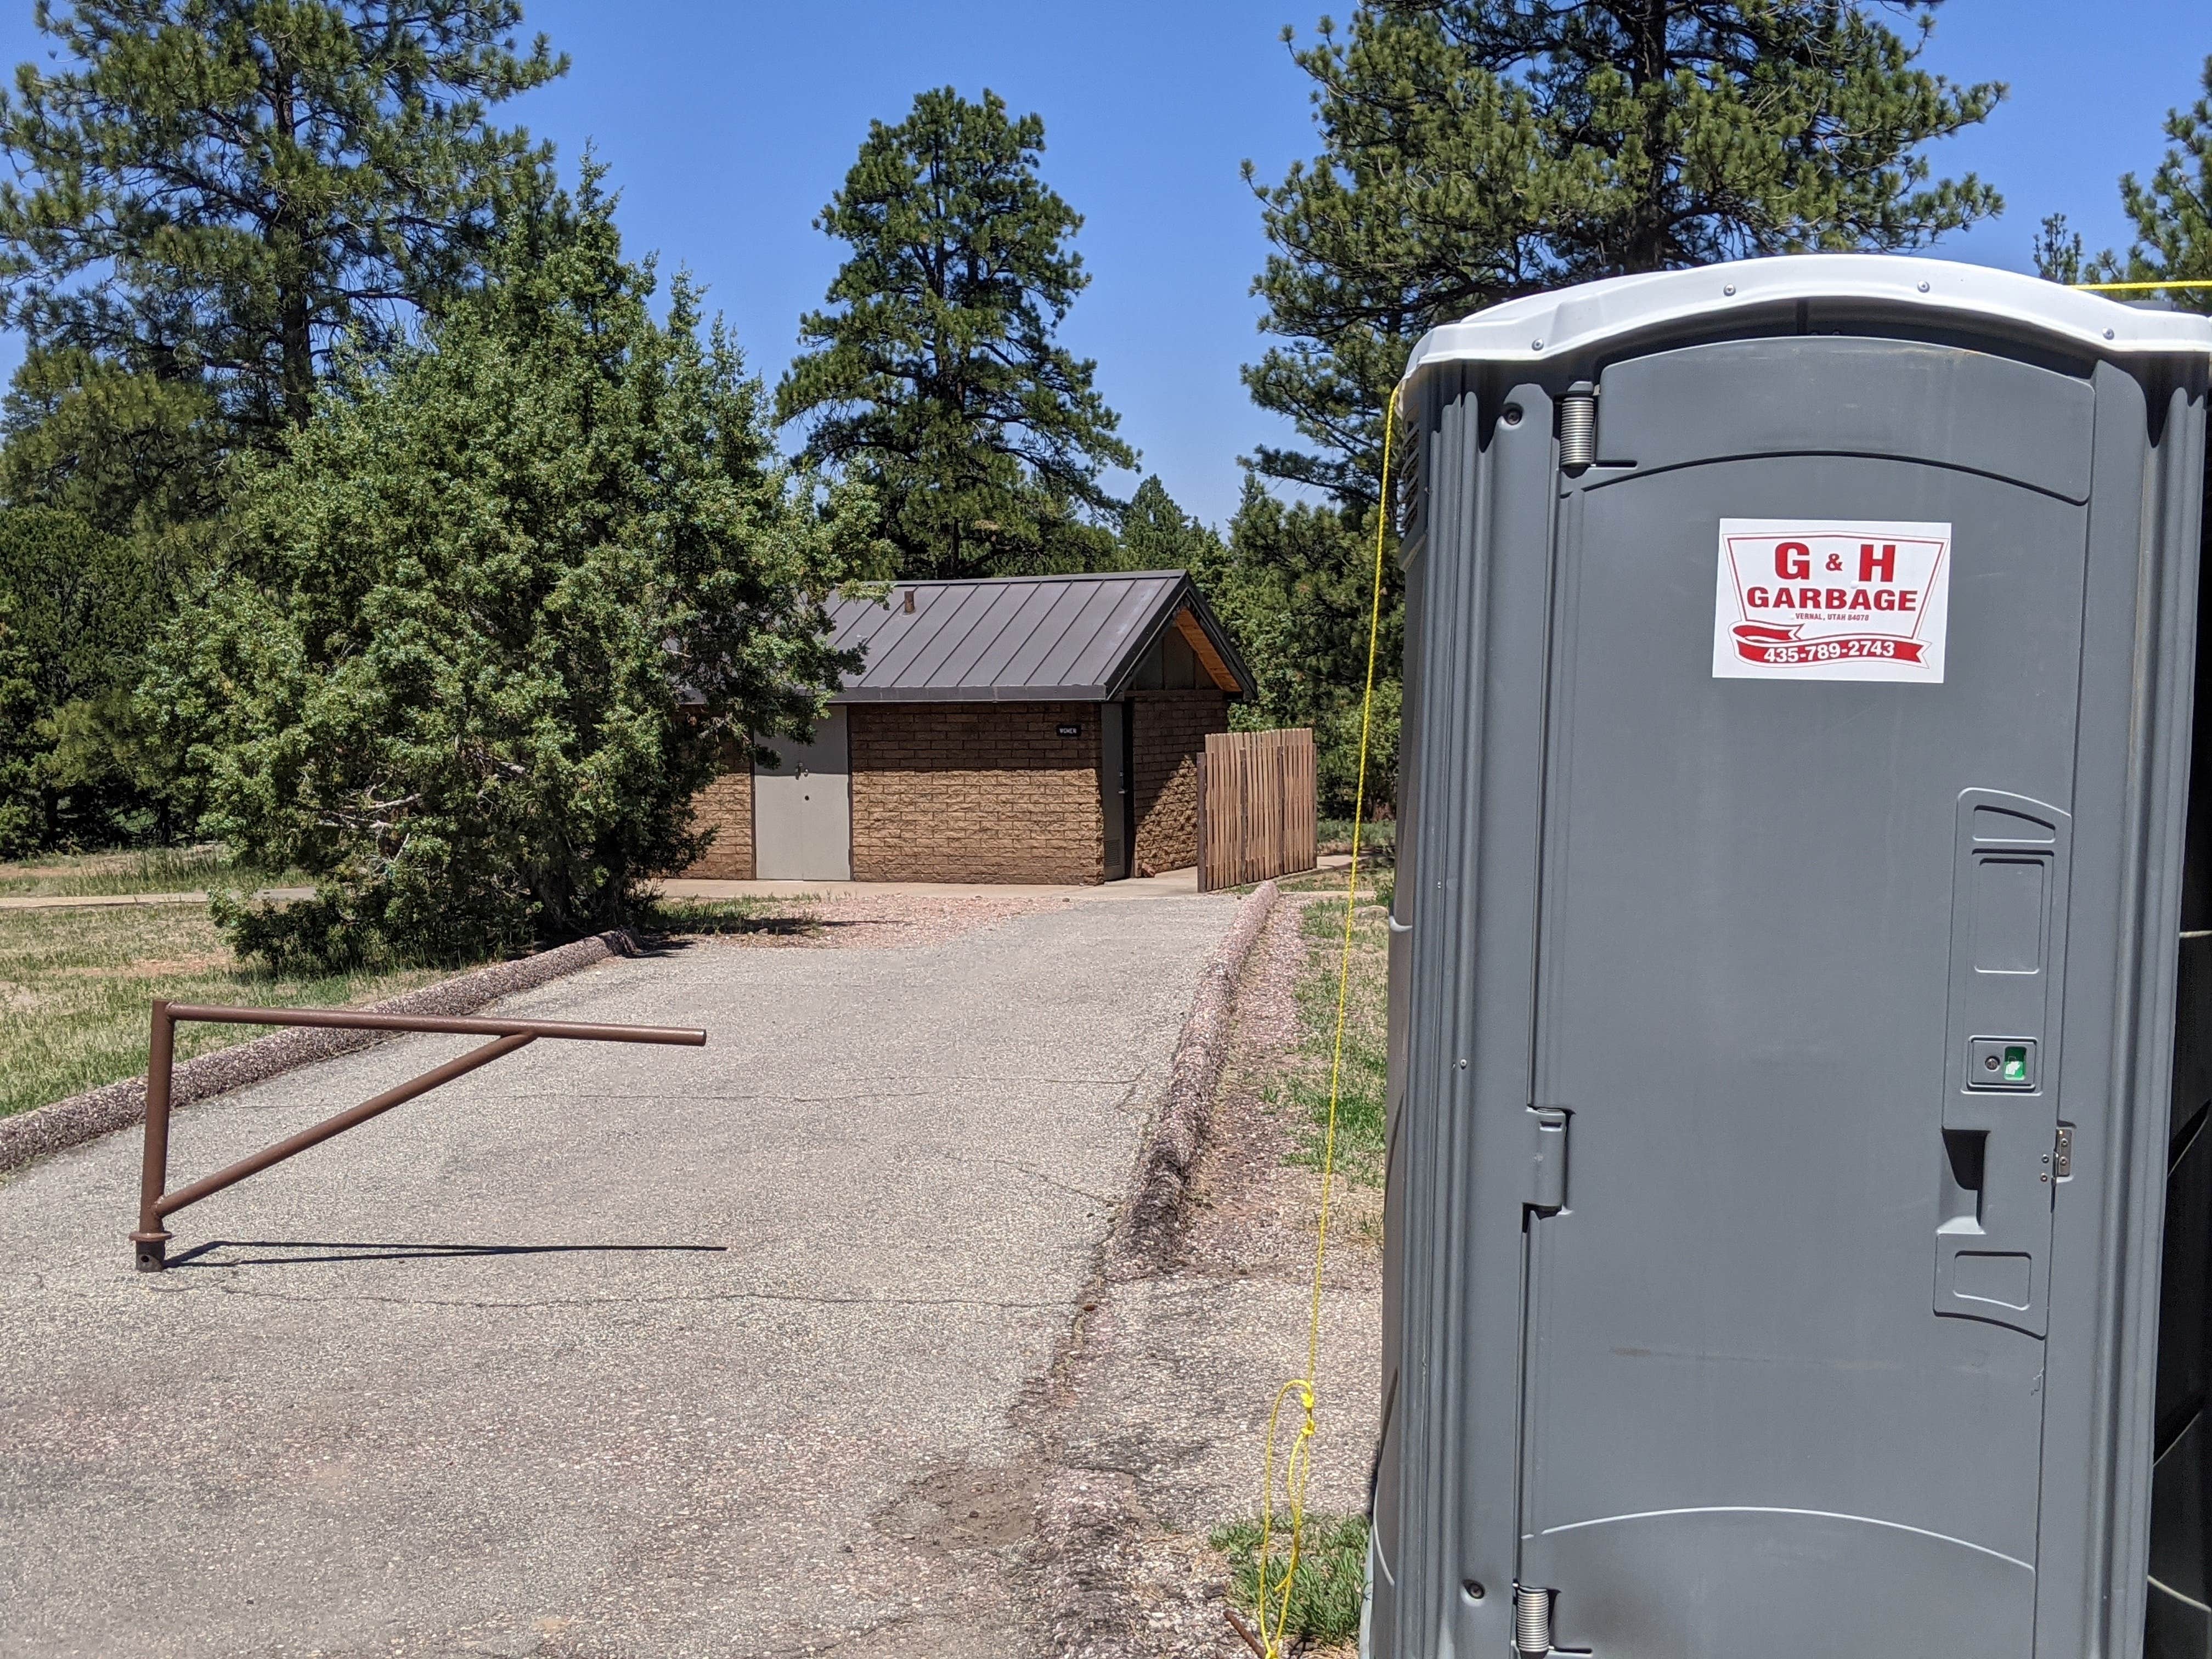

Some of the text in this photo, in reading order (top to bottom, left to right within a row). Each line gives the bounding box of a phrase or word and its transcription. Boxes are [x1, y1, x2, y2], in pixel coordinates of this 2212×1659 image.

[1775, 542, 1896, 582] G & H
[1747, 587, 1917, 611] GARBAGE
[1795, 613, 1826, 621] VERNAL,
[1764, 641, 1895, 663] 435-789-2743
